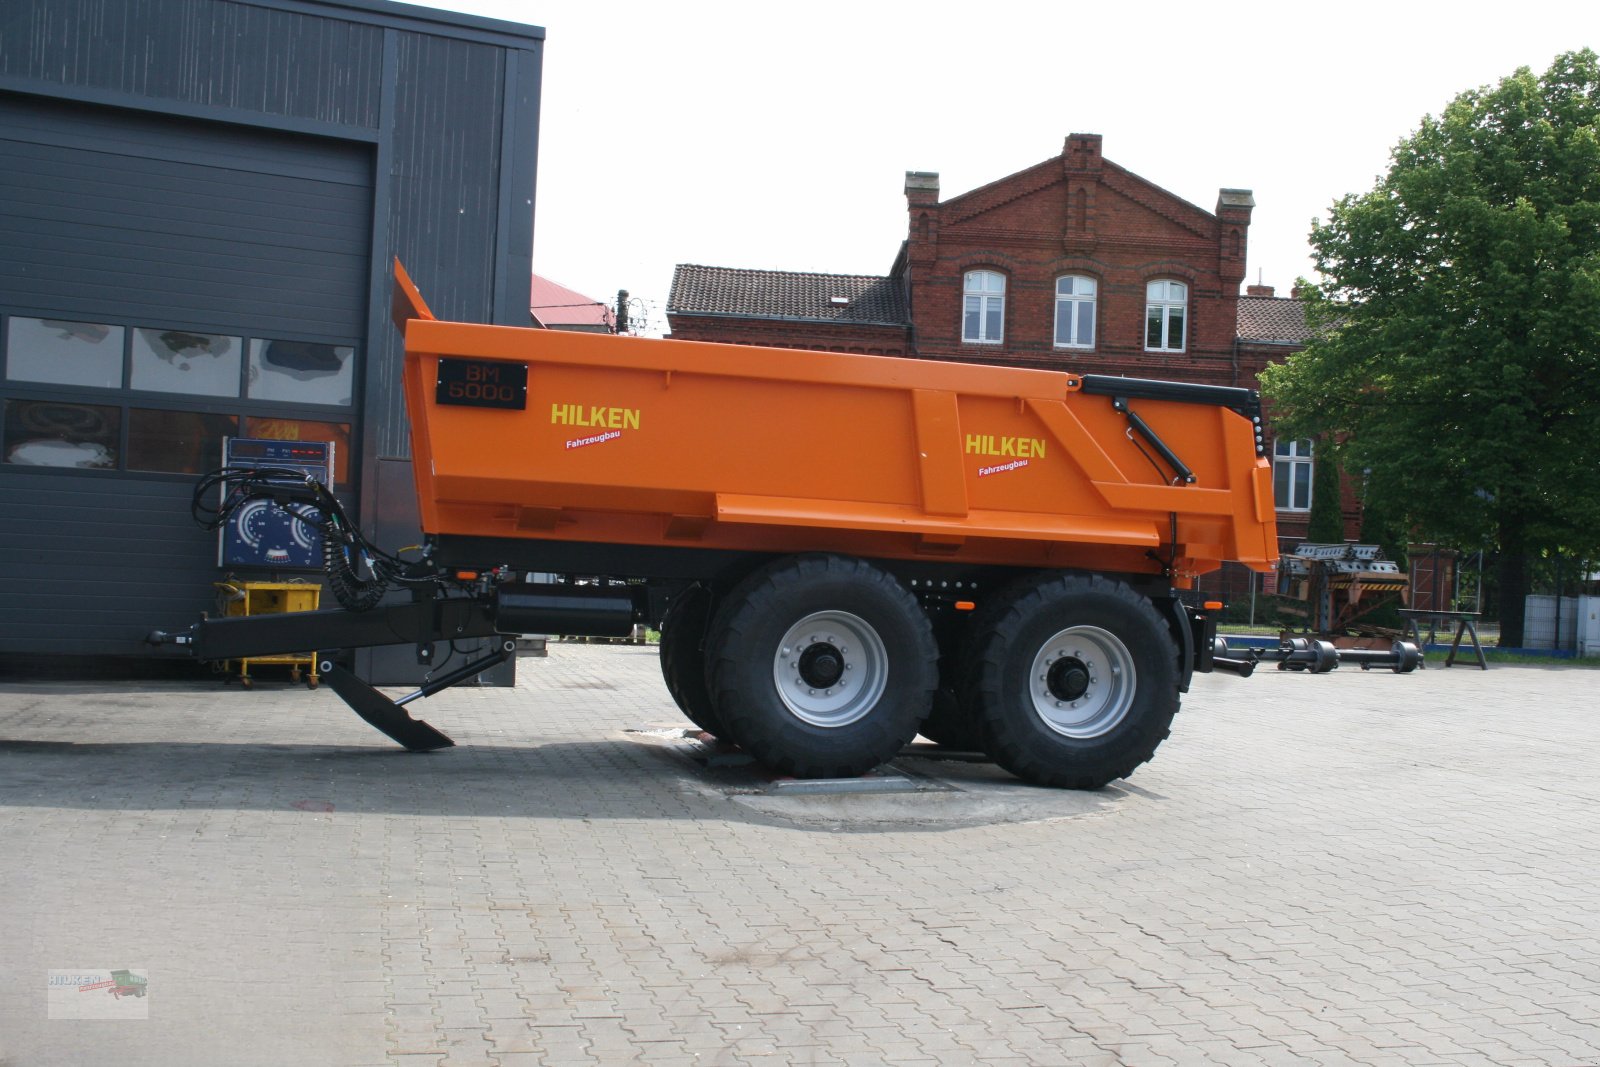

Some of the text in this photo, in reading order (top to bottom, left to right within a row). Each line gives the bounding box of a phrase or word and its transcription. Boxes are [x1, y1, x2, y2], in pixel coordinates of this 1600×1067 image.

[466, 365, 500, 383] BM
[551, 403, 640, 430] HILKEN
[565, 430, 621, 449] Fahrzeugbau
[965, 433, 1046, 459] HILKEN
[978, 459, 1029, 477] Fahrzeugbau
